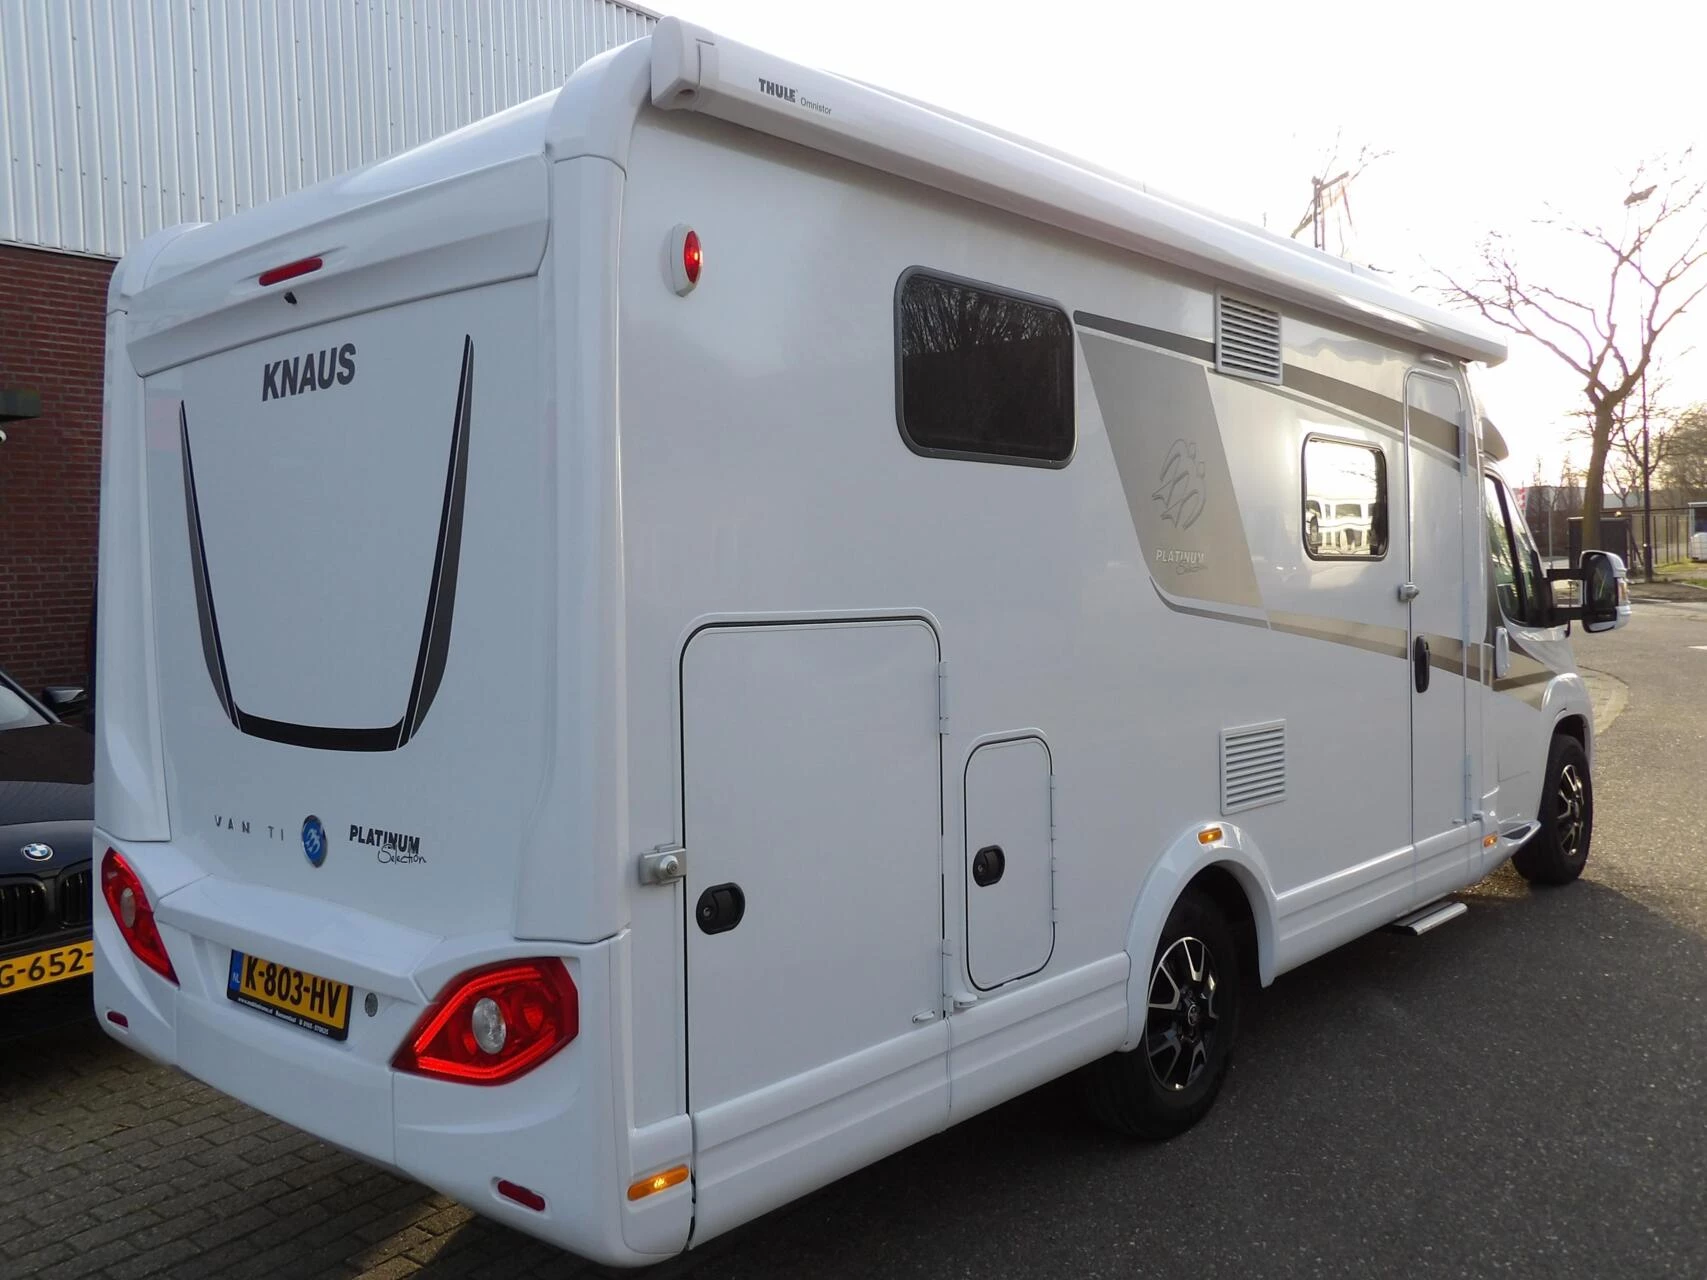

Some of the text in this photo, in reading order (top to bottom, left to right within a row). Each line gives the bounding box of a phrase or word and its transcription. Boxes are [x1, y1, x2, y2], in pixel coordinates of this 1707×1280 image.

[758, 77, 832, 115] THULE Omnistor
[261, 342, 357, 402] KNAUS
[214, 815, 284, 841] VAN TI
[350, 824, 420, 855] PLATINUM
[377, 843, 427, 864] Selection
[244, 955, 342, 1019] K-803-HV
